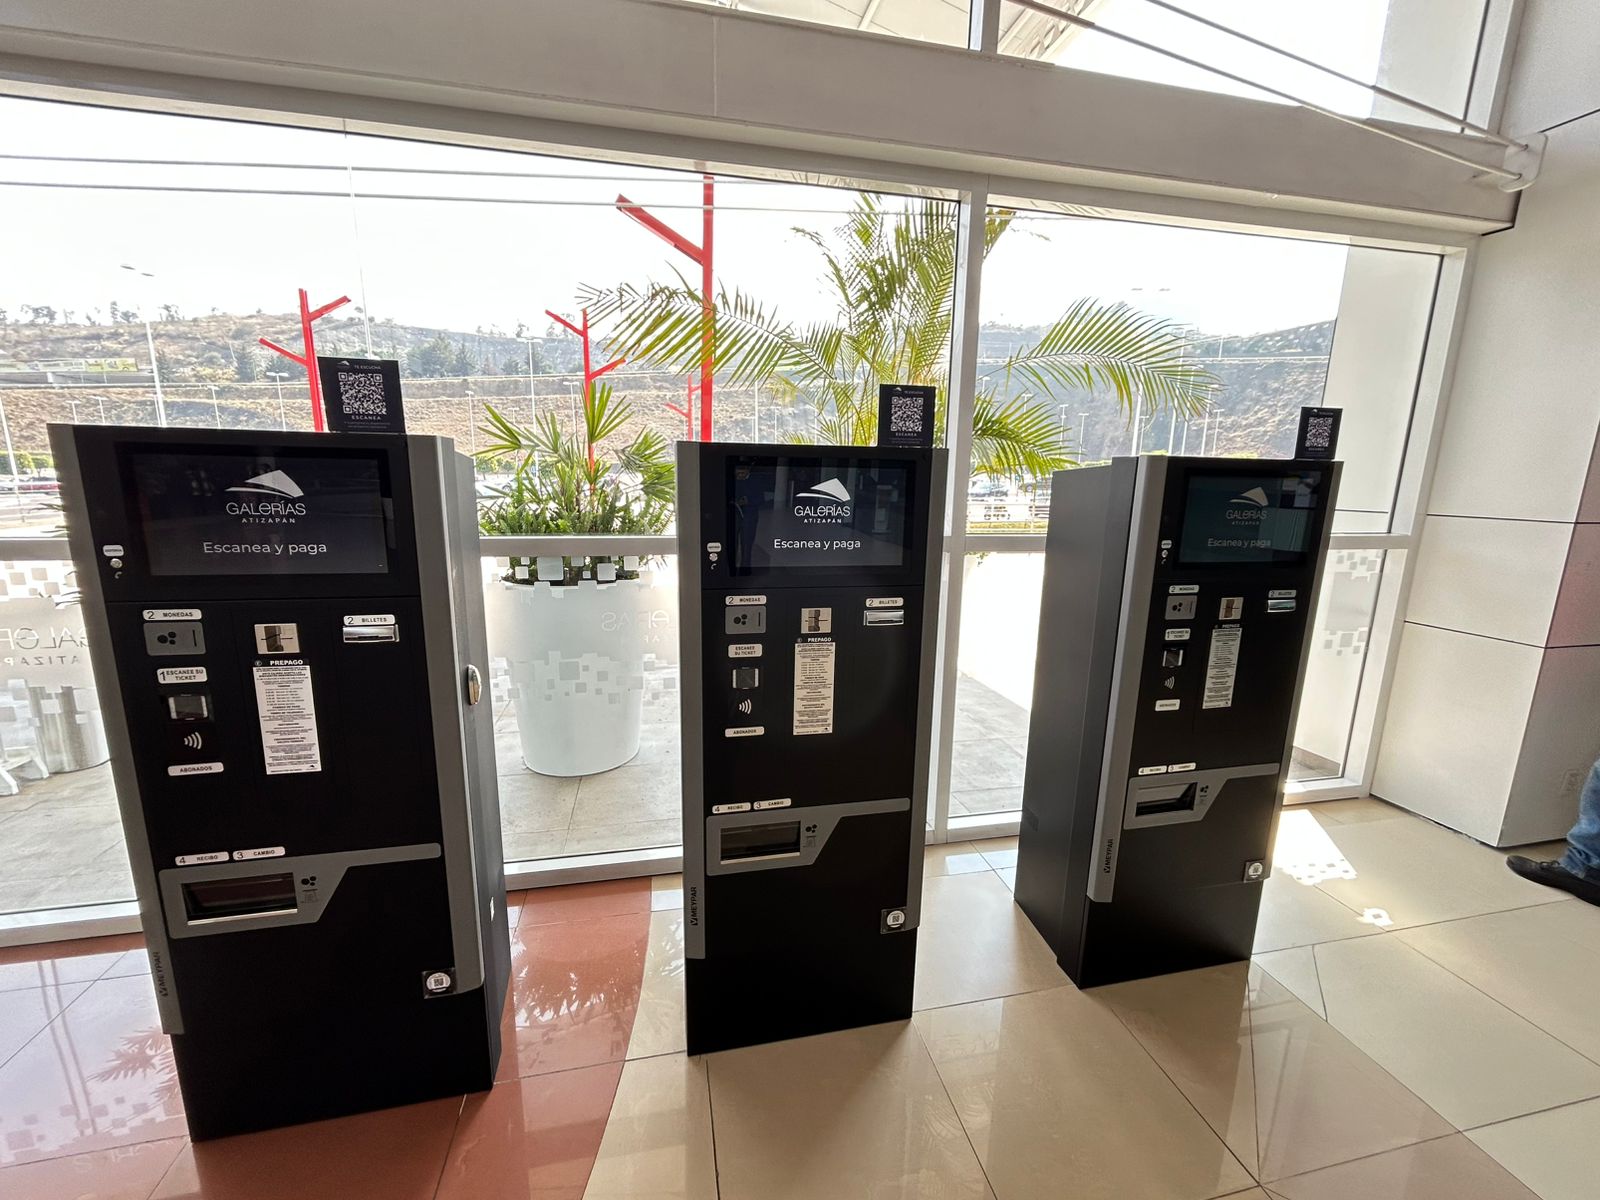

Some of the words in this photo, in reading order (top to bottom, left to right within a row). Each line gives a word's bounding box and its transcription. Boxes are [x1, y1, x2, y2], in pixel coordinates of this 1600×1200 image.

[202, 541, 271, 553] Escanea
[274, 543, 284, 555] y
[288, 543, 327, 555] paga
[773, 539, 821, 549] Escanea
[823, 540, 831, 550] y
[833, 540, 861, 550] paga
[728, 596, 734, 604] 2
[868, 599, 874, 607] 2
[146, 611, 155, 620] 2
[347, 616, 354, 625] 2
[160, 671, 166, 681] 1
[179, 765, 213, 773] ABONADOS
[236, 851, 244, 859] 3
[178, 856, 186, 864] 4
